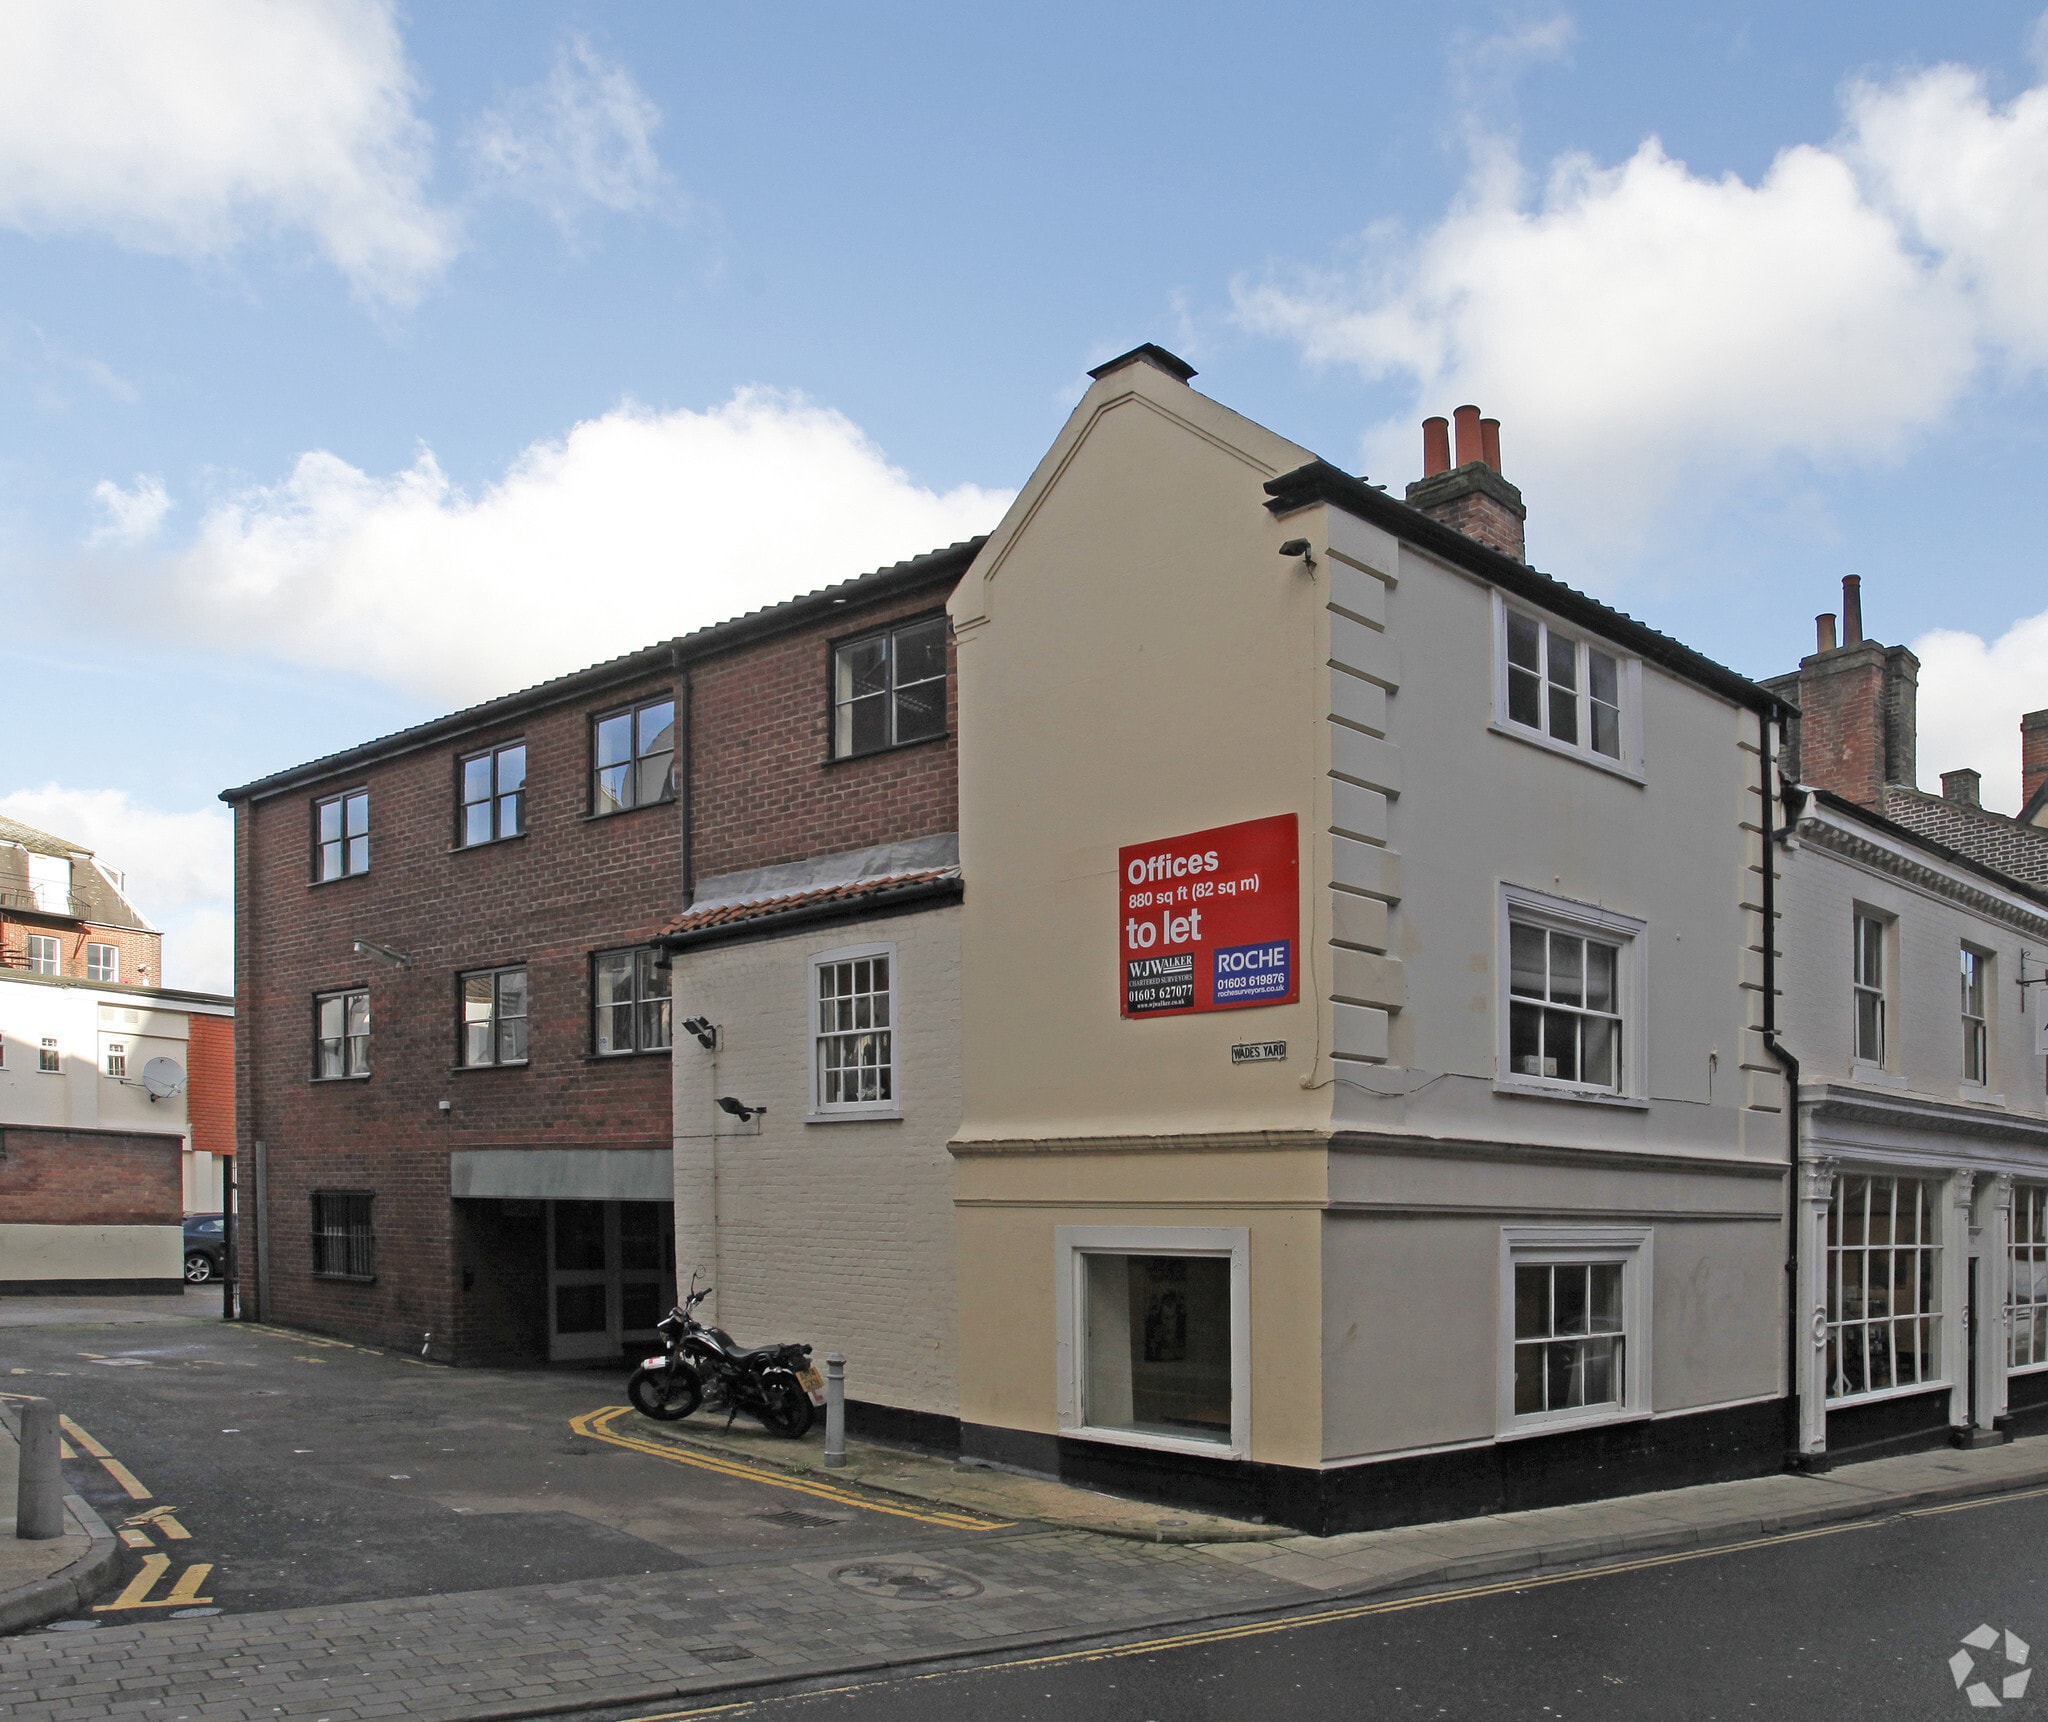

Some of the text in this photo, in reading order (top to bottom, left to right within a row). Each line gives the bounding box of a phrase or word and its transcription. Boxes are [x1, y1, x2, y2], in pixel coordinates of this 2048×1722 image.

[1127, 850, 1219, 885] Offices
[1128, 873, 1260, 909] 880 sq ft (82 sq m)
[1126, 908, 1202, 949] to let
[1218, 946, 1285, 973] ROCHE
[1129, 974, 1193, 987] CHARTERED SURVEYORS
[1217, 972, 1285, 990] 01603 619876
[1129, 984, 1193, 1003] 01603 627077
[1217, 984, 1285, 998] rochesurveyors.co.uk
[1233, 1044, 1284, 1060] WADES YARD
